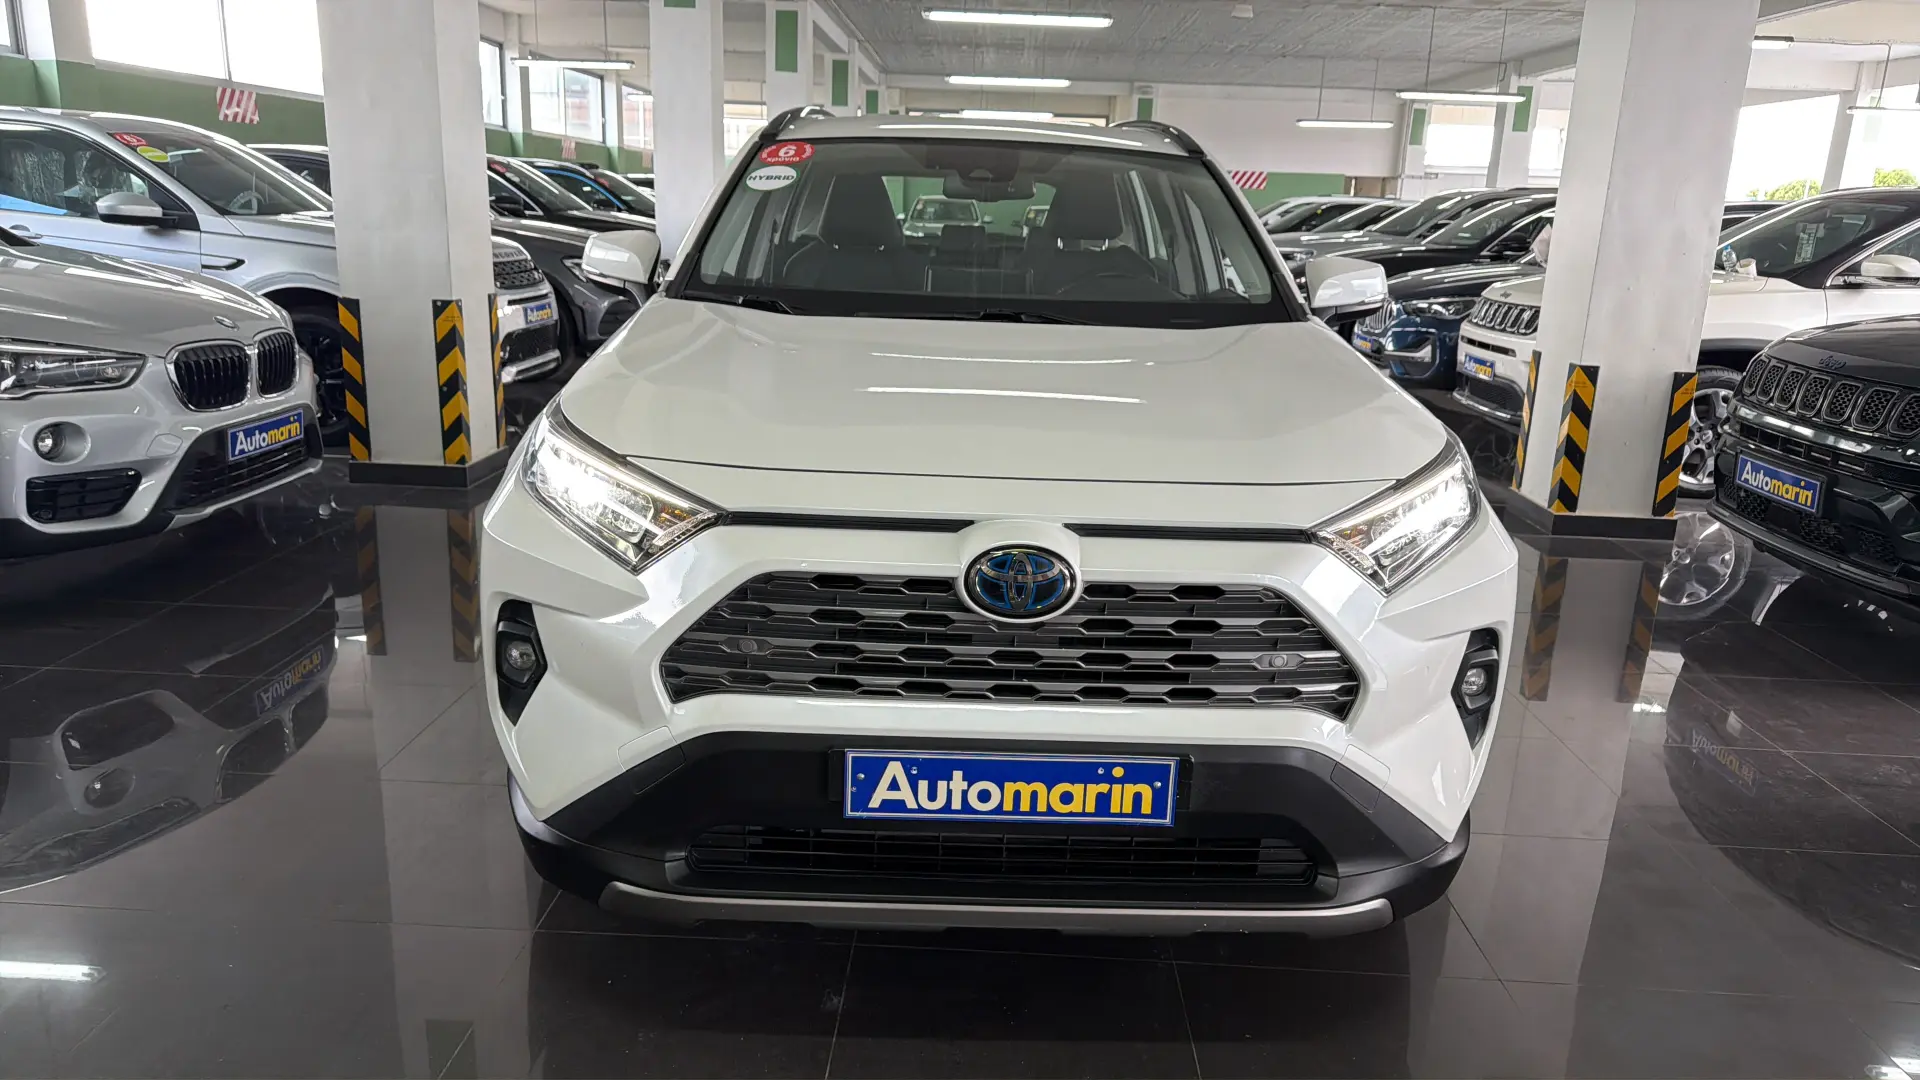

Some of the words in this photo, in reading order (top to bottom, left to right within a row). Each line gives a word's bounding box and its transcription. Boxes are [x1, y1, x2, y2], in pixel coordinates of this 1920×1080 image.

[779, 145, 797, 157] 6
[235, 416, 300, 455] Automarin
[1741, 461, 1813, 506] Automarin
[868, 760, 1152, 814] Automarin
